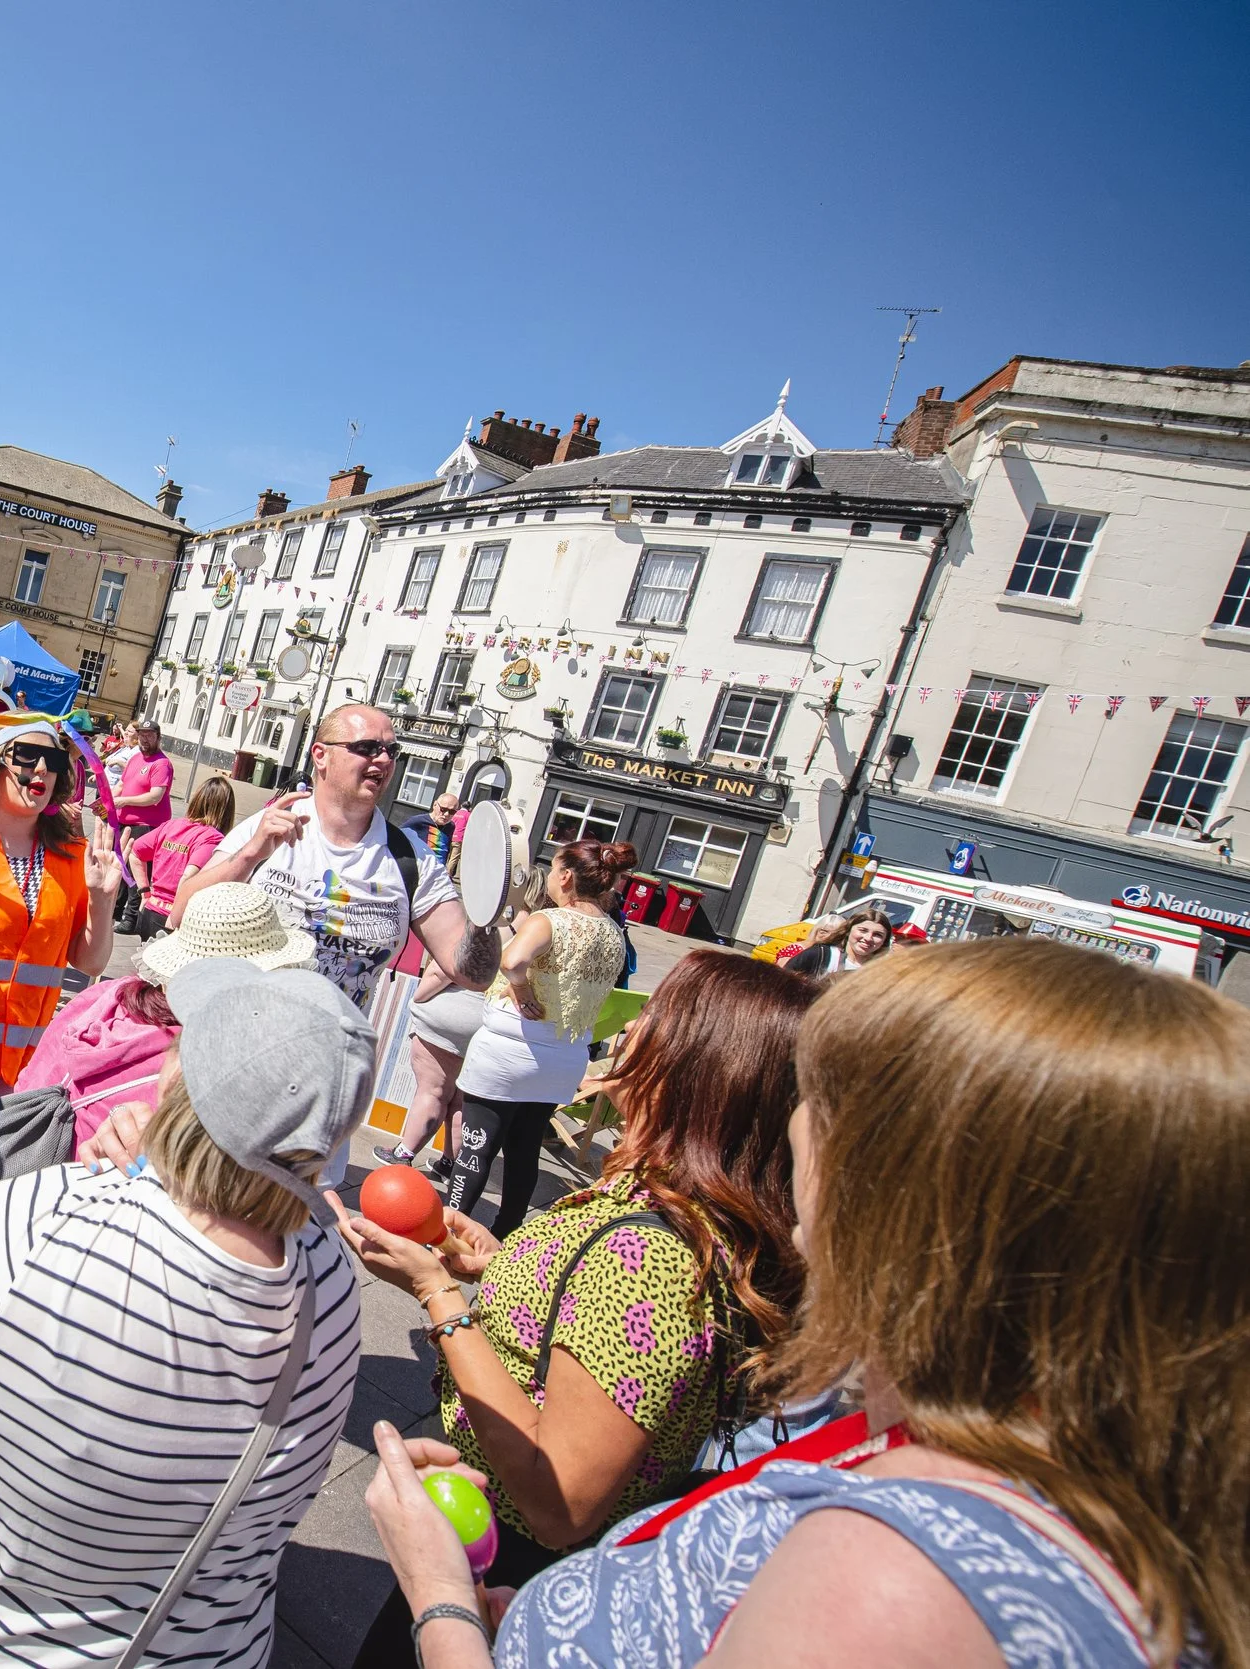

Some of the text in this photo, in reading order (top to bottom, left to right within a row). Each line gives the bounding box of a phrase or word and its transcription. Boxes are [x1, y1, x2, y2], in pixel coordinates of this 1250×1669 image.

[19, 506, 58, 524] COURT
[59, 516, 97, 534] HOUSE
[5, 602, 32, 616] COURT
[33, 608, 60, 622] HOUSE
[607, 645, 670, 664] INN
[30, 669, 66, 684] Market
[430, 723, 450, 736] INN
[583, 751, 755, 797] The MARKET INN
[267, 868, 296, 887] YOU
[981, 889, 1056, 914] Michael's
[350, 917, 400, 940] MATTERS
[450, 1174, 467, 1211] ORNIA
